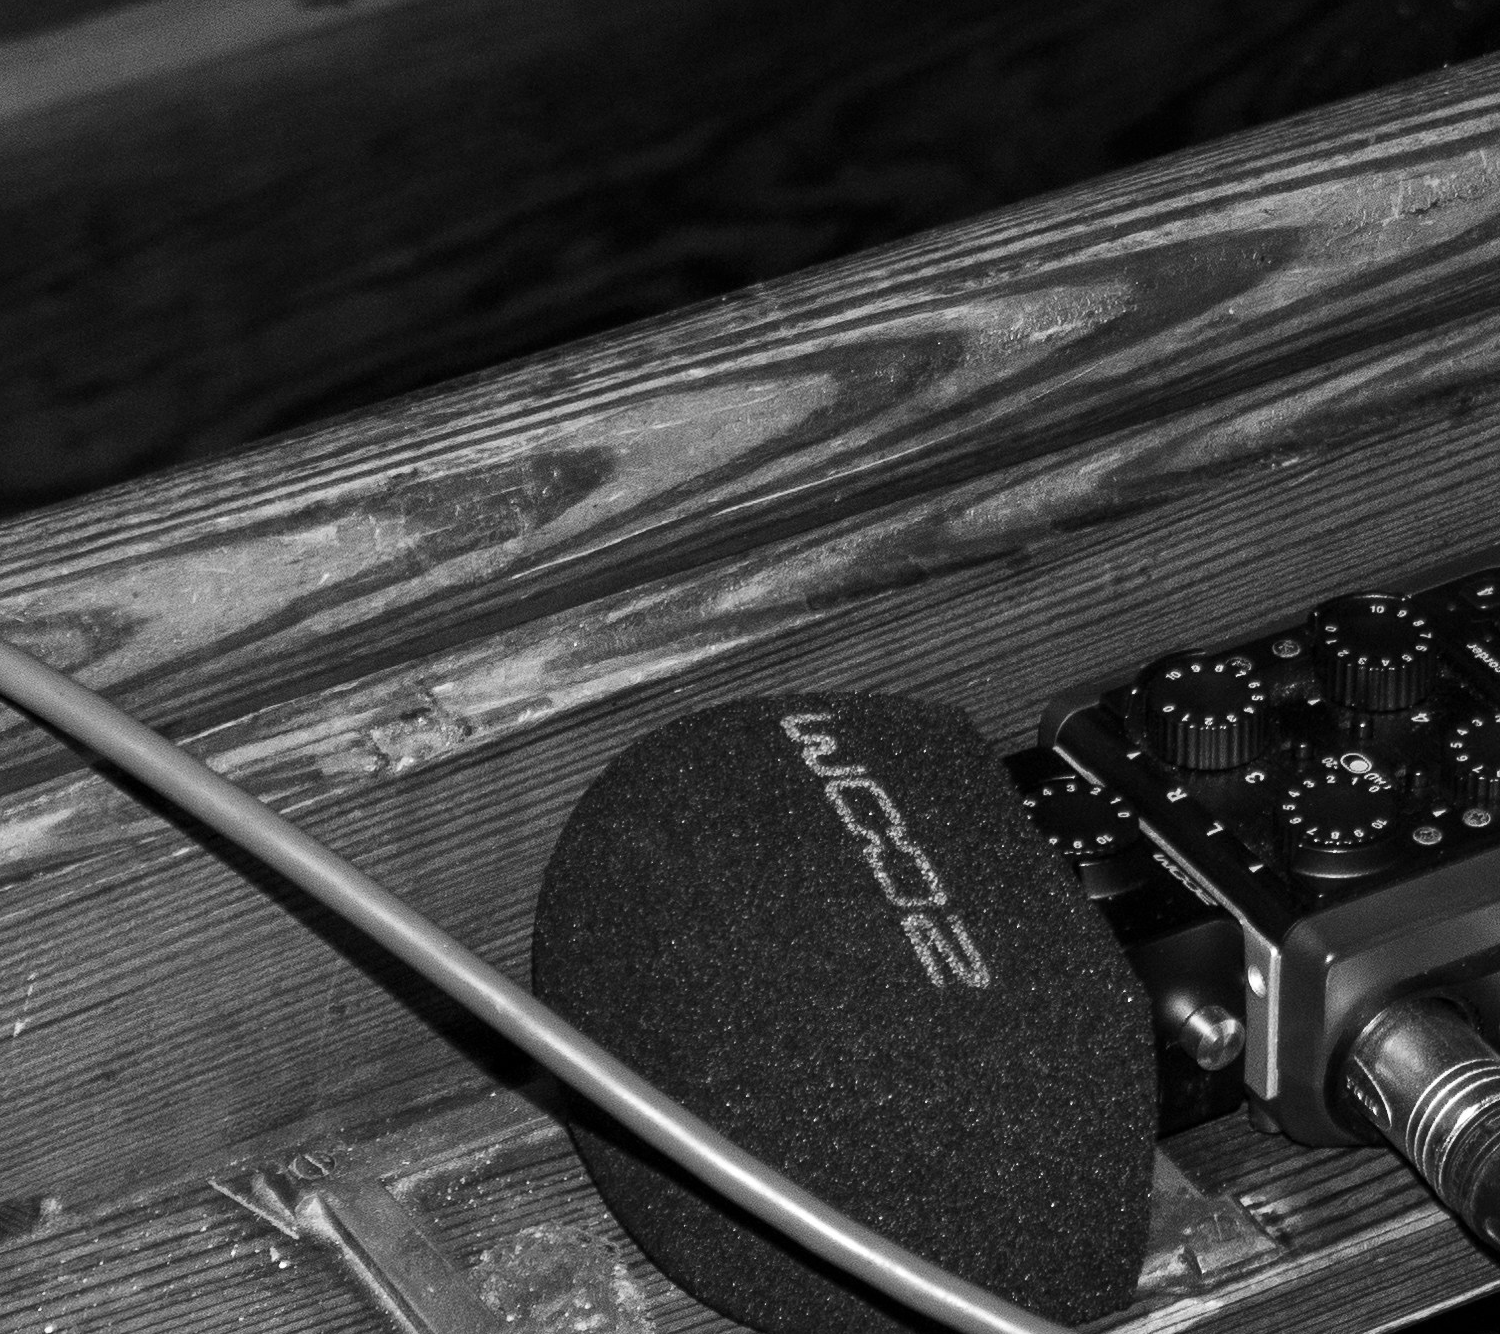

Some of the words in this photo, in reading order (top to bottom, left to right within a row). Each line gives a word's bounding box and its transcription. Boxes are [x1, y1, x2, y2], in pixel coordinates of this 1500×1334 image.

[1369, 604, 1386, 614] 10
[1449, 741, 1464, 749] 5
[1455, 754, 1469, 762] 6
[1325, 774, 1336, 784] 2
[1166, 786, 1188, 803] R
[1282, 803, 1296, 811] 5
[1206, 821, 1224, 837] L
